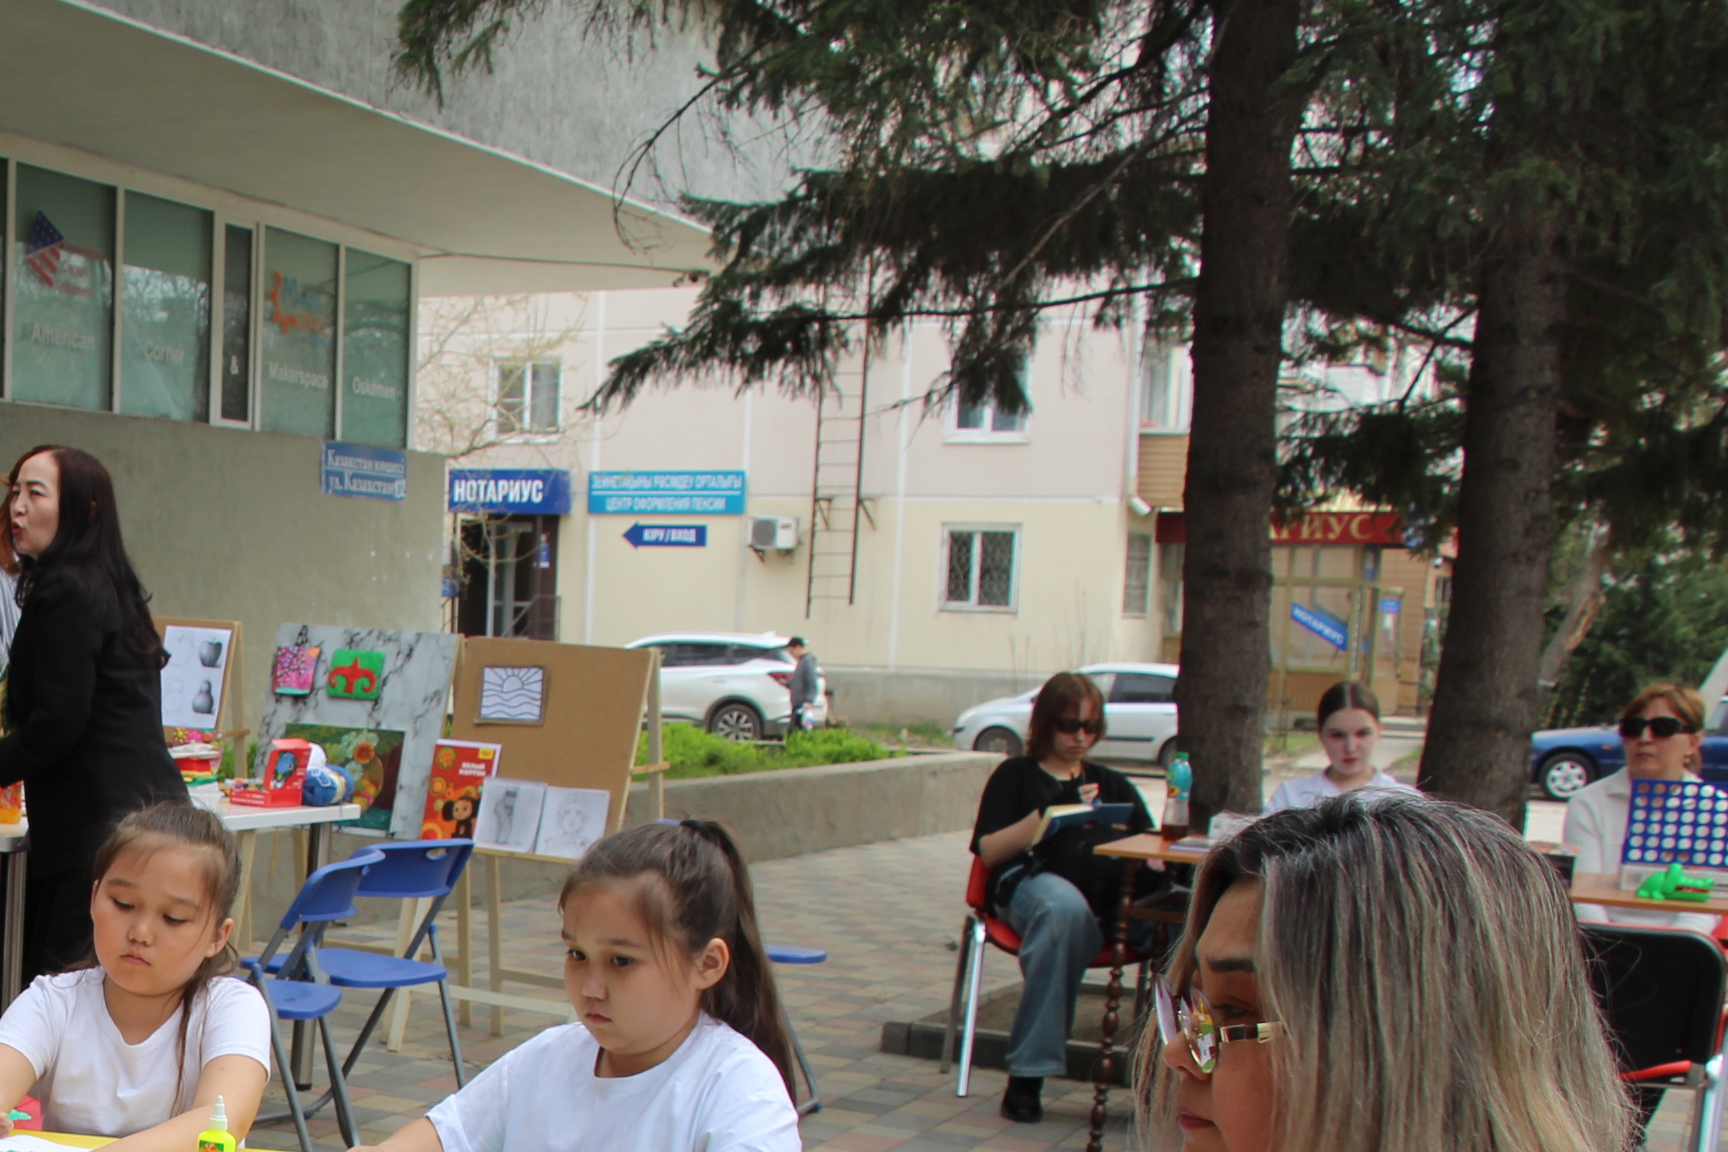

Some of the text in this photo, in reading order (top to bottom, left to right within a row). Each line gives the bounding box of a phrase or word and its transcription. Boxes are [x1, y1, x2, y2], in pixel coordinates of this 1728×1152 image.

[31, 321, 95, 351] American
[269, 361, 328, 388] Makerspace
[453, 479, 544, 504] НОТАРИУС
[606, 497, 726, 511] ЦЕНТР ОФОРМЛЕНИЯ ПЕНСИИ
[671, 528, 696, 542] ВХОД
